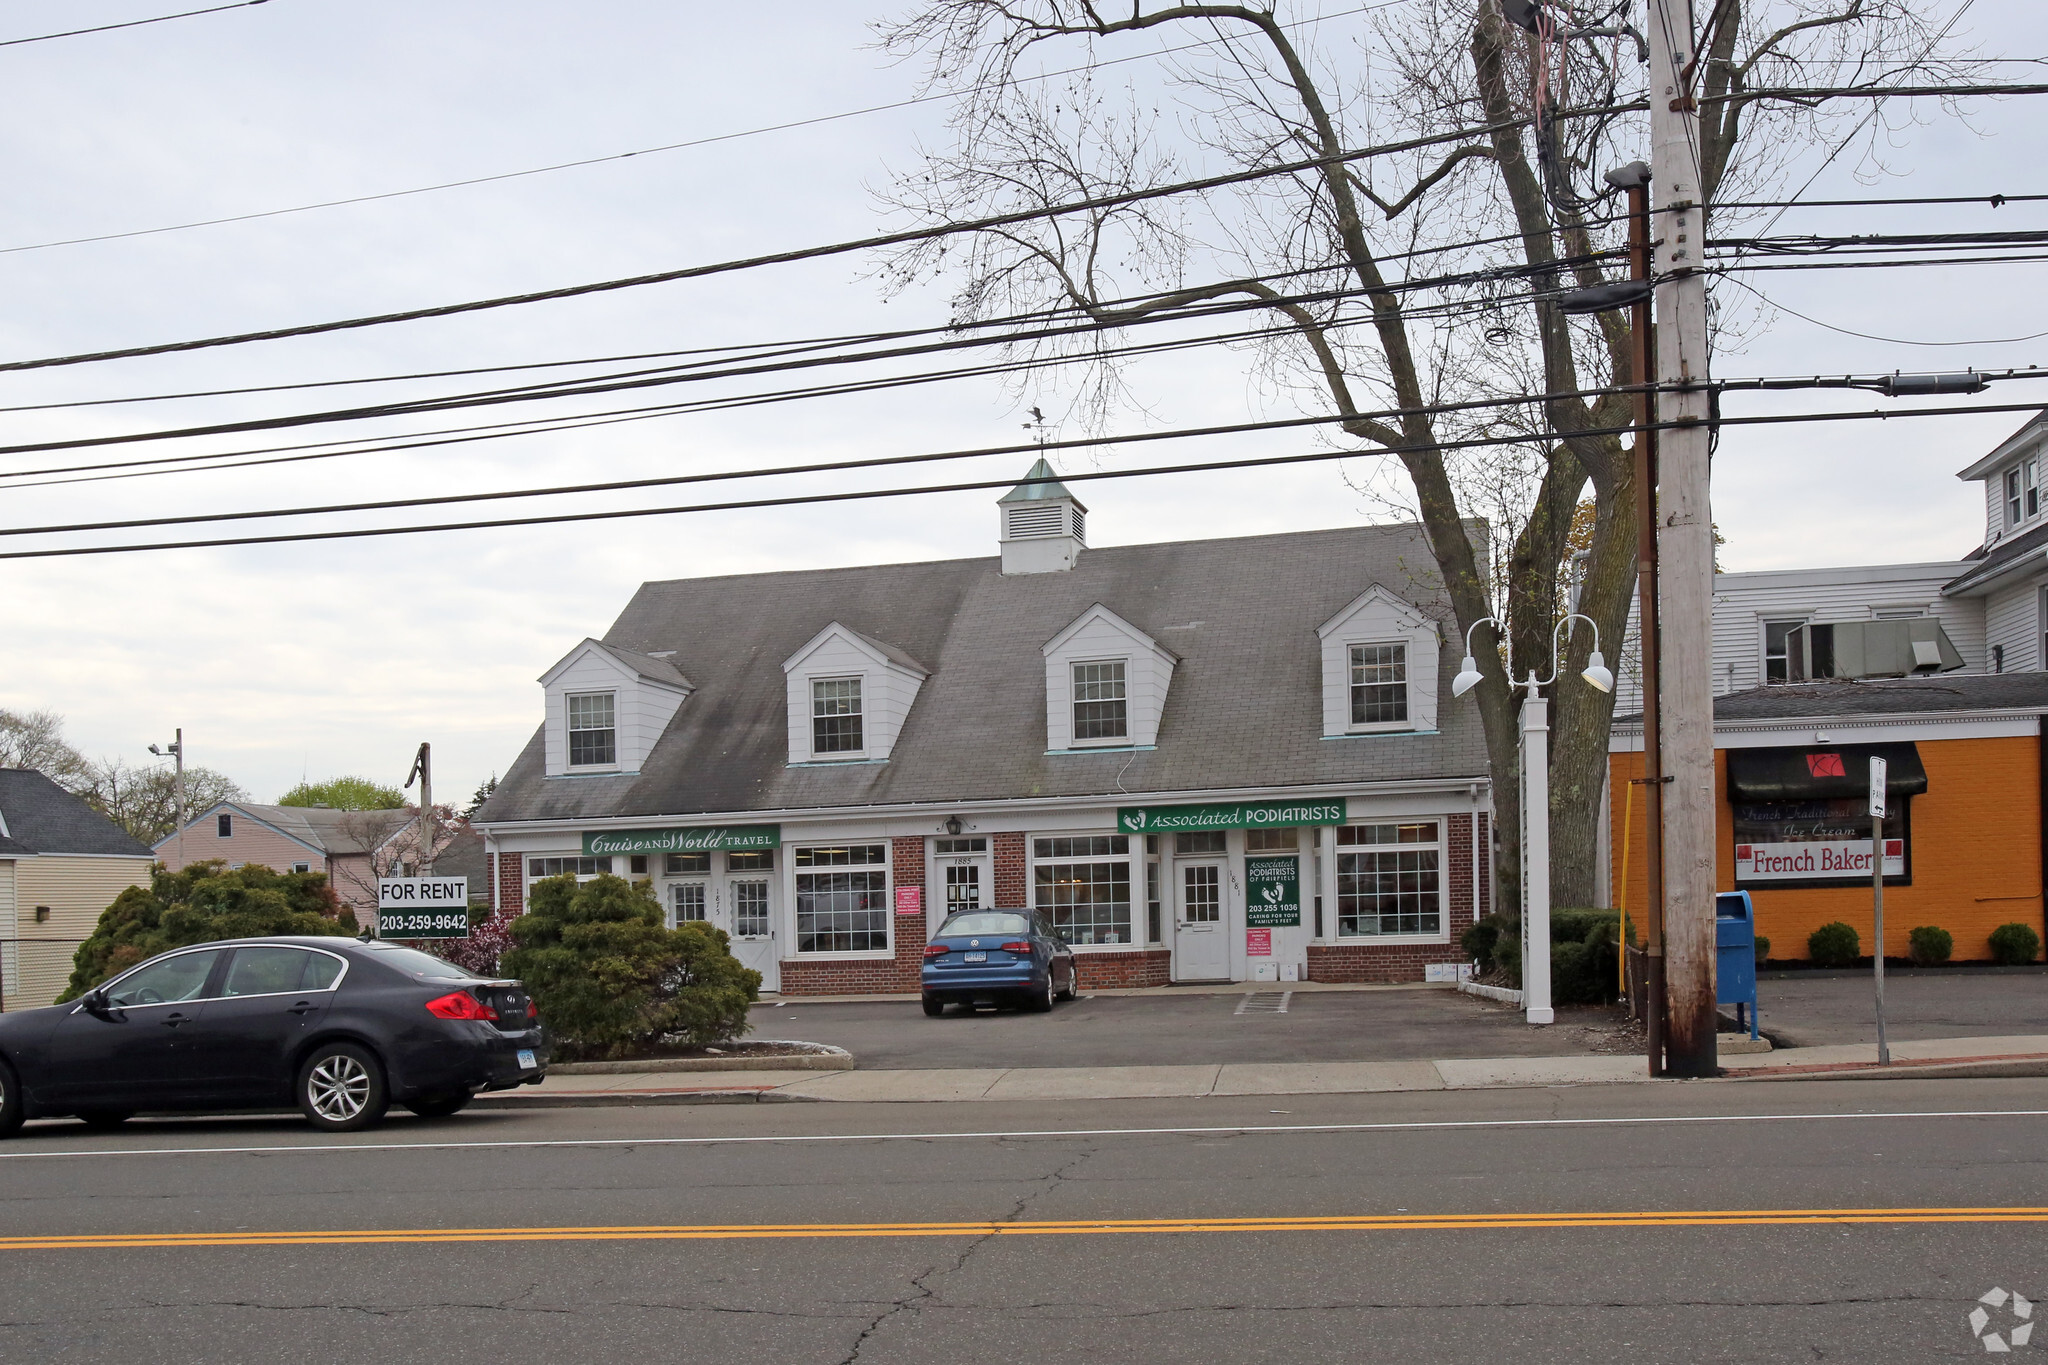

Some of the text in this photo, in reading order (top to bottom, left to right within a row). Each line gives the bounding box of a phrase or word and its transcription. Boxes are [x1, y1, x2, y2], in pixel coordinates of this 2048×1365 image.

[1150, 805, 1341, 827] Associated PODIATRISTS
[1811, 822, 1856, 837] Cream
[590, 829, 773, 854] Cruise AND World TRAVEL
[954, 857, 972, 865] 1885
[1249, 858, 1295, 869] Associated
[1753, 848, 1815, 873] French
[1249, 867, 1296, 877] PODIATRISTS
[381, 883, 465, 900] FOR RENT
[1248, 903, 1298, 912] 203 255 1036
[380, 914, 467, 931] 203-259-9642
